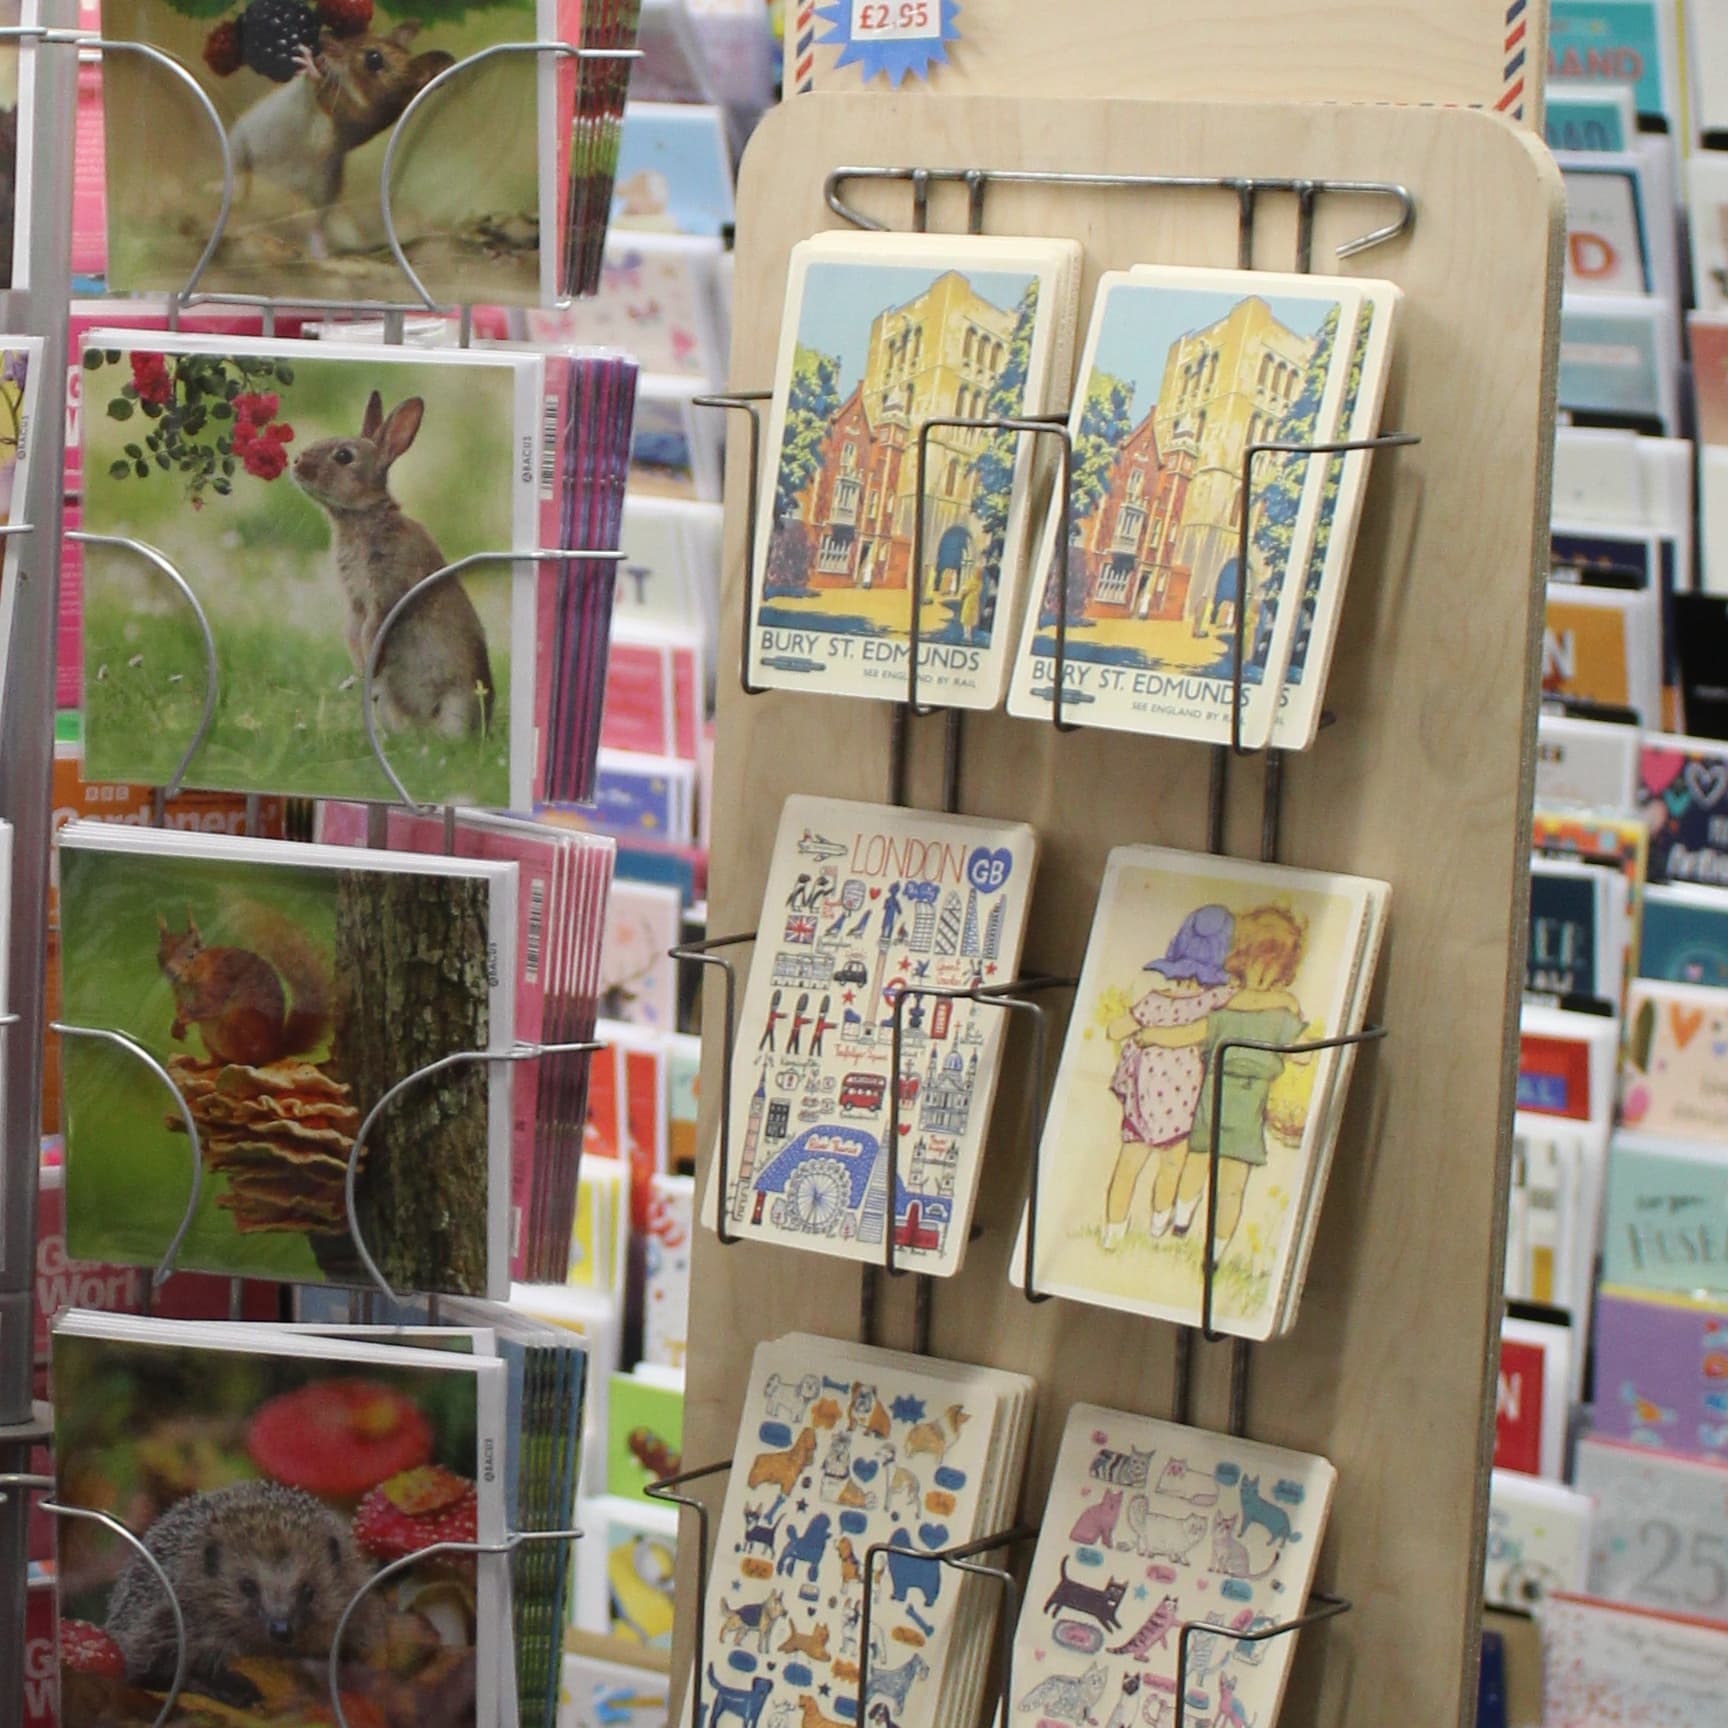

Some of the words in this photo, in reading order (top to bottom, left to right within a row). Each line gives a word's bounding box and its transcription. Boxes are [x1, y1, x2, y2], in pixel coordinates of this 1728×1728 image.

[858, 2, 929, 31] £2.95
[760, 630, 821, 655] BURY
[828, 636, 855, 659] ST.
[862, 641, 981, 672] EDMUNDS
[863, 668, 879, 679] SEE
[881, 669, 932, 684] ENGLND
[1032, 660, 1091, 686] BURY
[1099, 671, 1124, 692] ST.
[1133, 673, 1251, 708] EDMUNDS
[1132, 701, 1147, 712] SEE
[1151, 703, 1201, 720] ENGLAND
[1206, 712, 1220, 722] BY
[850, 832, 967, 885] LONDON
[972, 858, 1006, 887] GB
